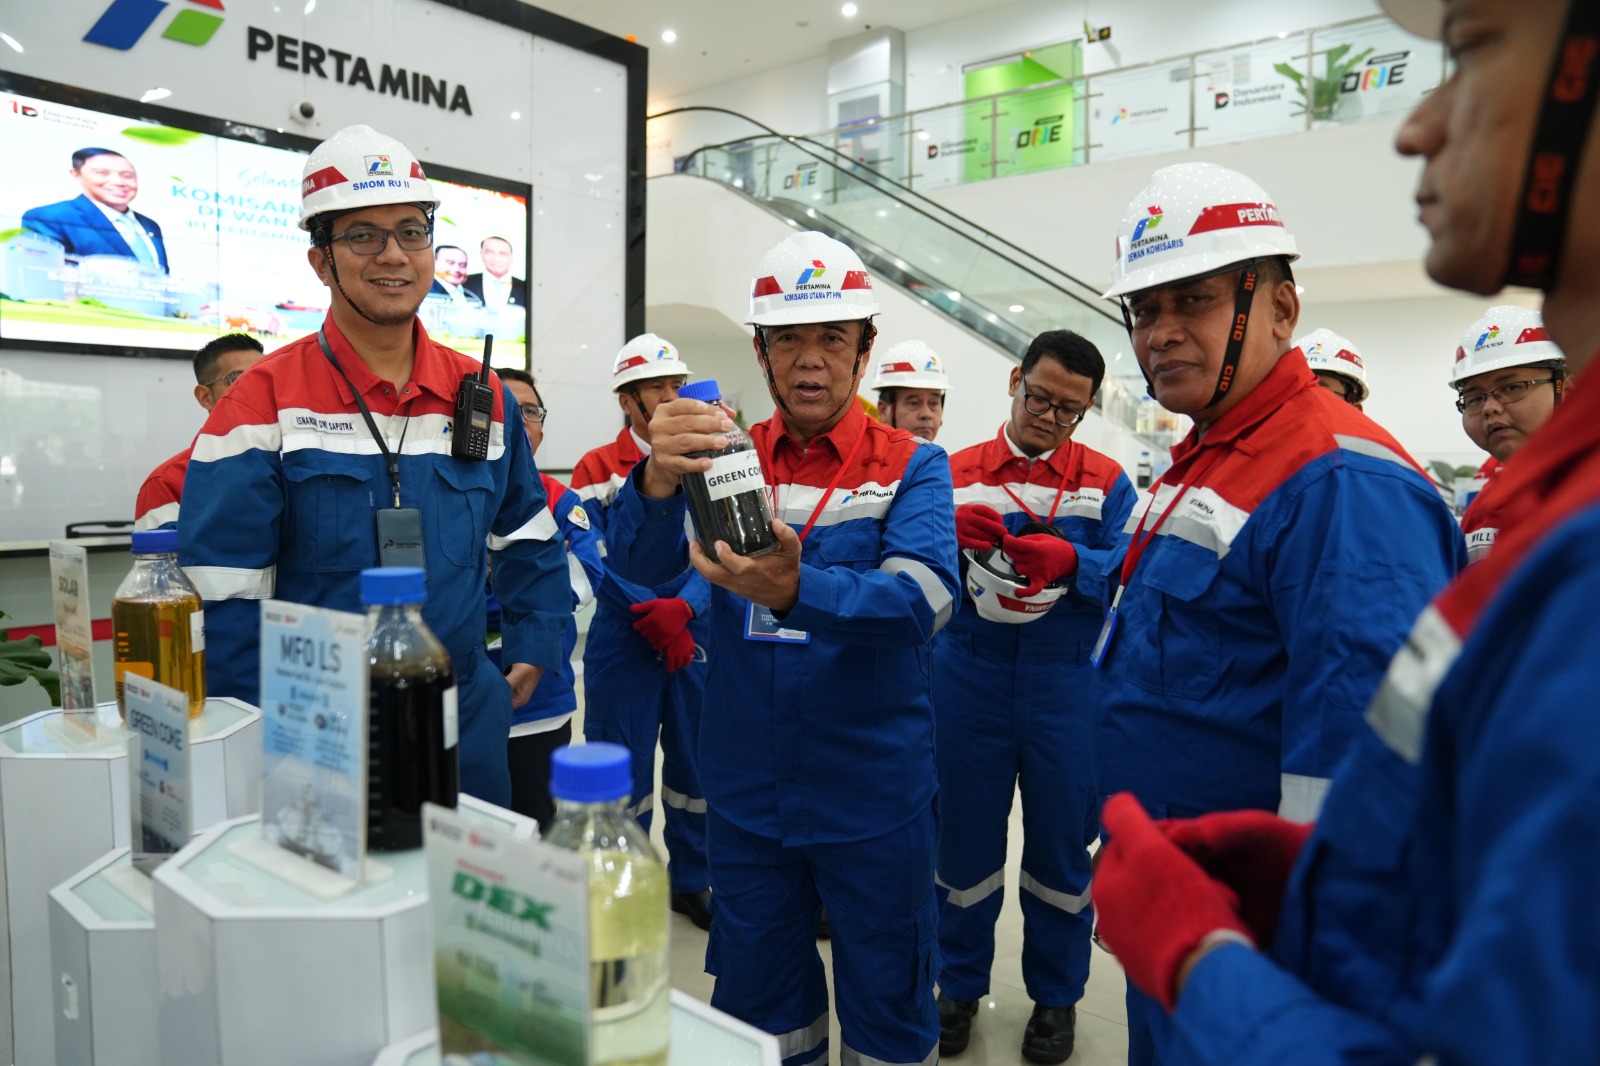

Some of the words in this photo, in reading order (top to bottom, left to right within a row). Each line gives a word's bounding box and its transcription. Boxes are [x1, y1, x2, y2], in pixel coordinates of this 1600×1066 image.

[247, 26, 473, 116] PERTAMINA
[1016, 125, 1062, 148] ONE
[353, 180, 384, 190] SMOM
[1131, 234, 1168, 250] PERTAMINA
[1146, 238, 1184, 256] KOMISARIS
[784, 292, 808, 301] KOMISARIS
[329, 422, 353, 430] SAPUTRA
[708, 470, 746, 486] GREEN
[58, 576, 79, 598] SOLAR
[280, 634, 315, 668] MFO
[319, 640, 342, 673] LS
[130, 709, 158, 738] GREEN
[160, 719, 182, 750] COKE
